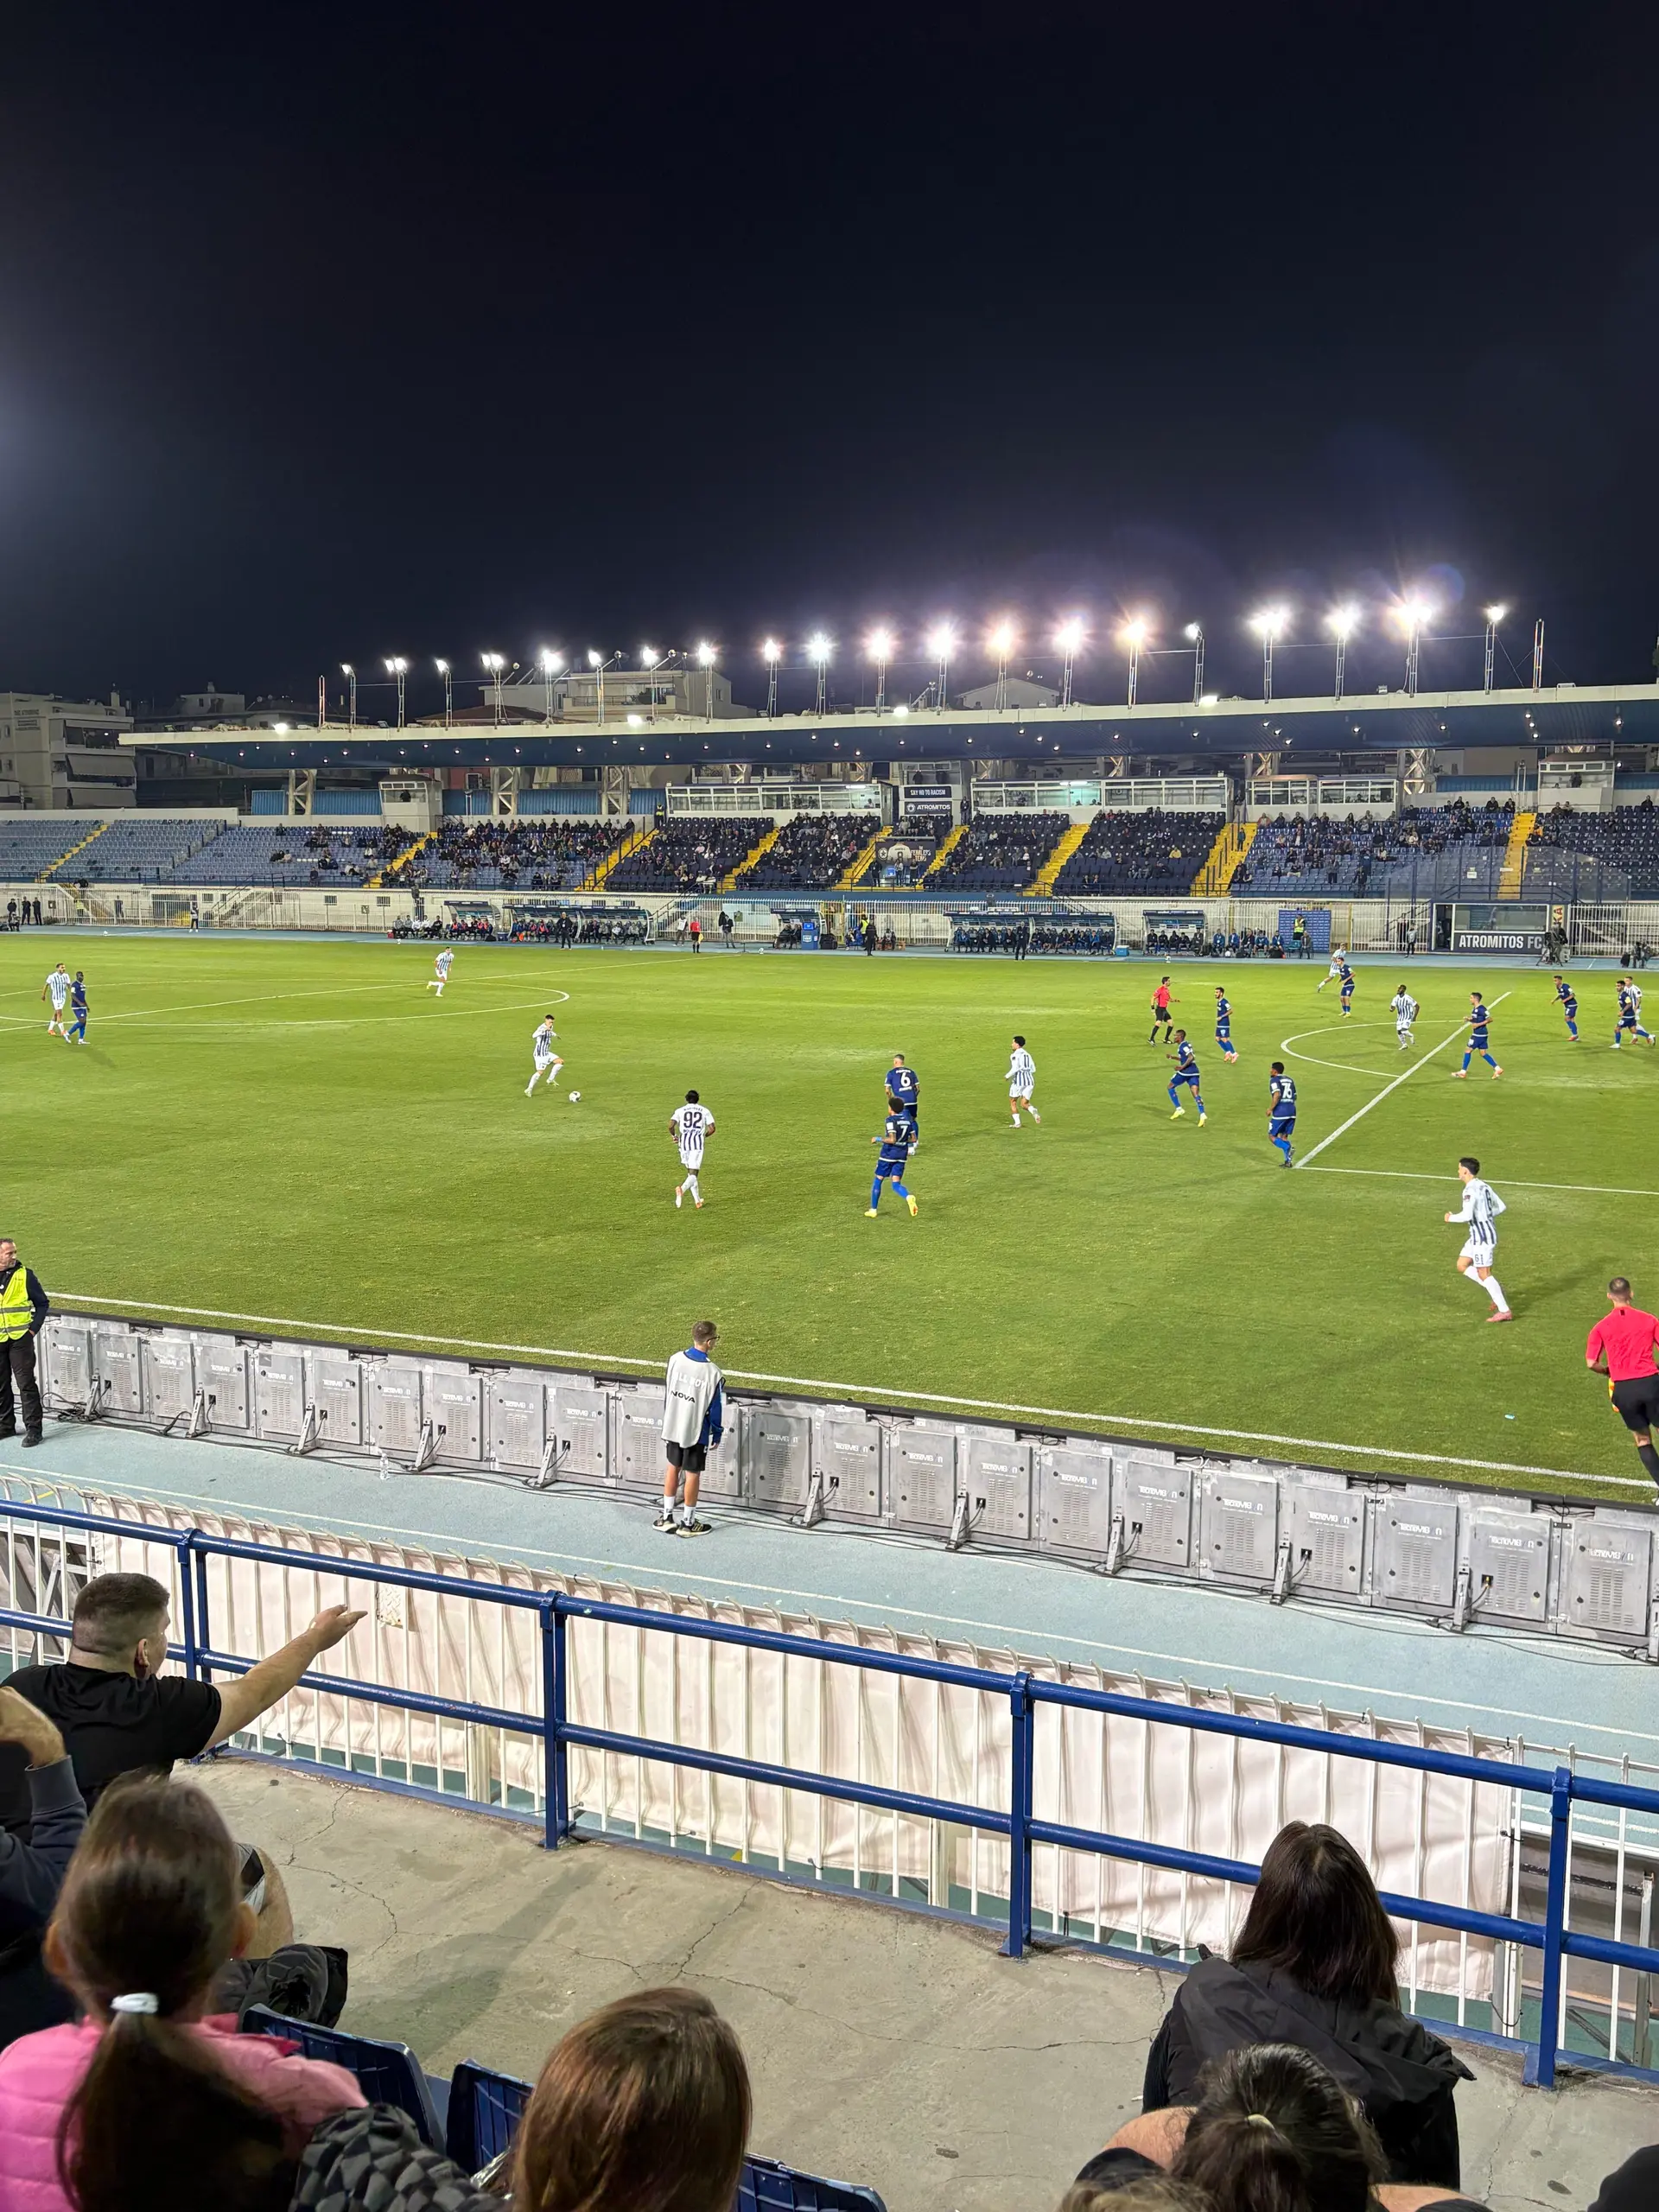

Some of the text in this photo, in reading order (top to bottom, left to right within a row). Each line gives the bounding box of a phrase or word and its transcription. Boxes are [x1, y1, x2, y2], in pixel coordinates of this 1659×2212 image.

[1459, 935, 1542, 950] ATROMITOS FC
[900, 1071, 911, 1087] 6
[683, 1111, 702, 1128] 92
[898, 1125, 908, 1142] 7
[671, 1390, 696, 1403] NOVA
